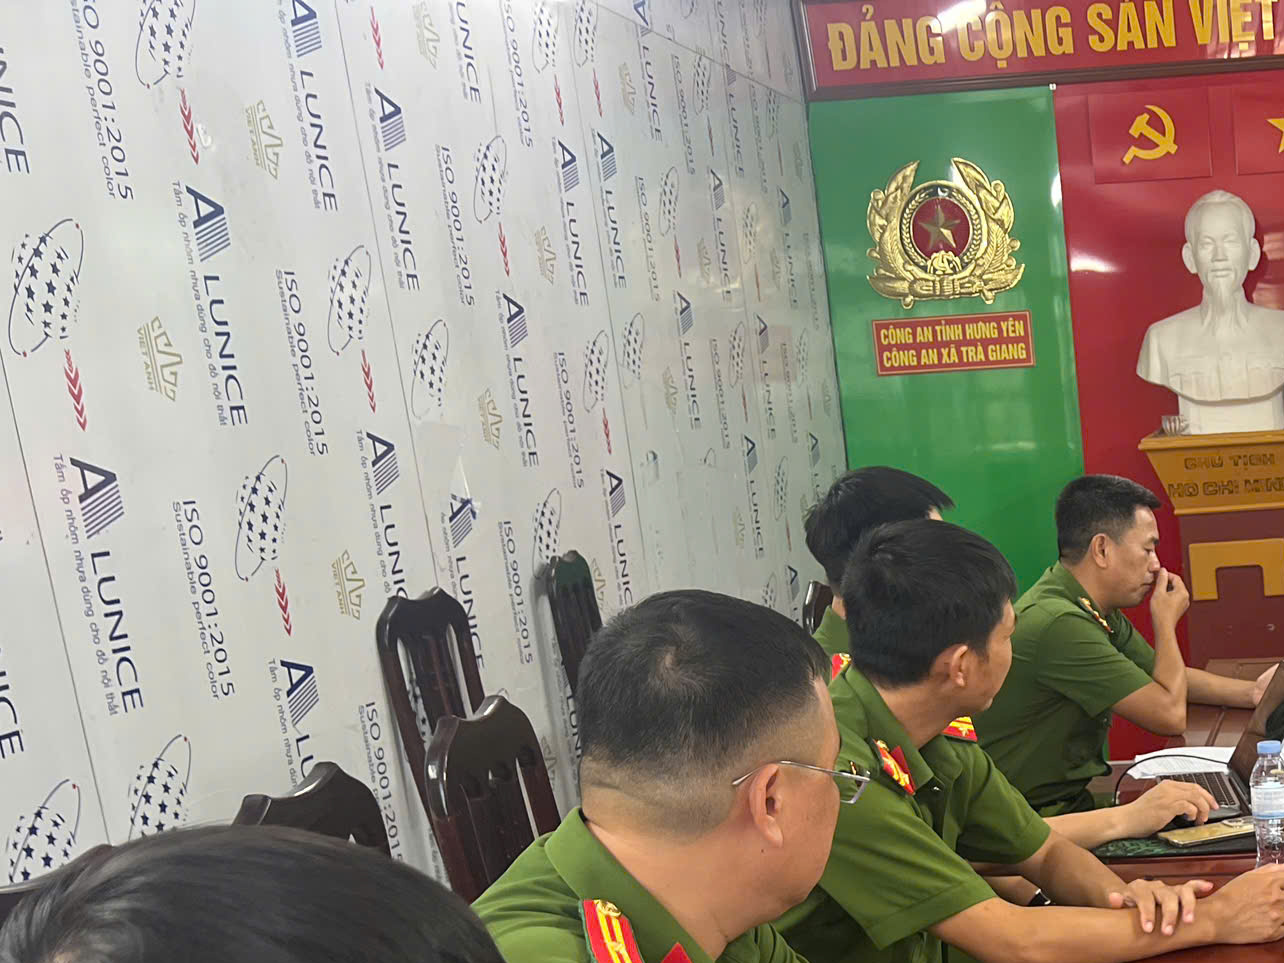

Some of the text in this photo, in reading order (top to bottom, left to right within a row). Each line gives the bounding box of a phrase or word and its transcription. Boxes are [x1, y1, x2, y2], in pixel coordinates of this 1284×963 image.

[456, 1, 481, 104] UNICE
[827, 4, 946, 71] ĐẢNG
[958, 0, 1074, 69] CỘNG
[85, 84, 117, 199] perfect color
[89, 39, 134, 200] 9001:2015
[300, 70, 338, 211] LUNICE
[511, 39, 533, 148] 9001:2015
[642, 45, 662, 141] LUNICE
[388, 162, 420, 291] LUNICE
[440, 145, 475, 306] ISO 9001:2015
[566, 201, 589, 306] LUNICE
[605, 190, 626, 289] LUNICE
[203, 337, 214, 359] cho
[204, 275, 248, 427] LUNICE
[274, 269, 317, 457] Sustainable perfect color
[283, 269, 328, 455] ISO 9001:2015
[881, 325, 913, 345] CÔNG
[916, 327, 933, 343] AN
[1000, 318, 1025, 337] YÊN
[883, 343, 1027, 367] CÔNG AN XÃ TRÀ GIANG
[513, 357, 539, 467] LUNICE
[557, 351, 584, 488] ISO 9001:2015
[52, 454, 68, 483] Tấm
[59, 487, 73, 505] ốp
[65, 508, 80, 544] nhôm
[72, 549, 89, 583] nhựa
[380, 504, 409, 598] LUNI
[380, 559, 389, 577] cho
[614, 524, 634, 605] LUNIC
[80, 585, 96, 617] dùng
[90, 621, 103, 645] cho
[91, 550, 144, 713] LUNICE
[171, 500, 221, 701] Sustainable perfect color
[183, 500, 236, 697] ISO 9001:2015
[502, 520, 534, 664] ISO 9001:2015
[96, 648, 108, 665] đồ
[364, 701, 382, 741] ISO
